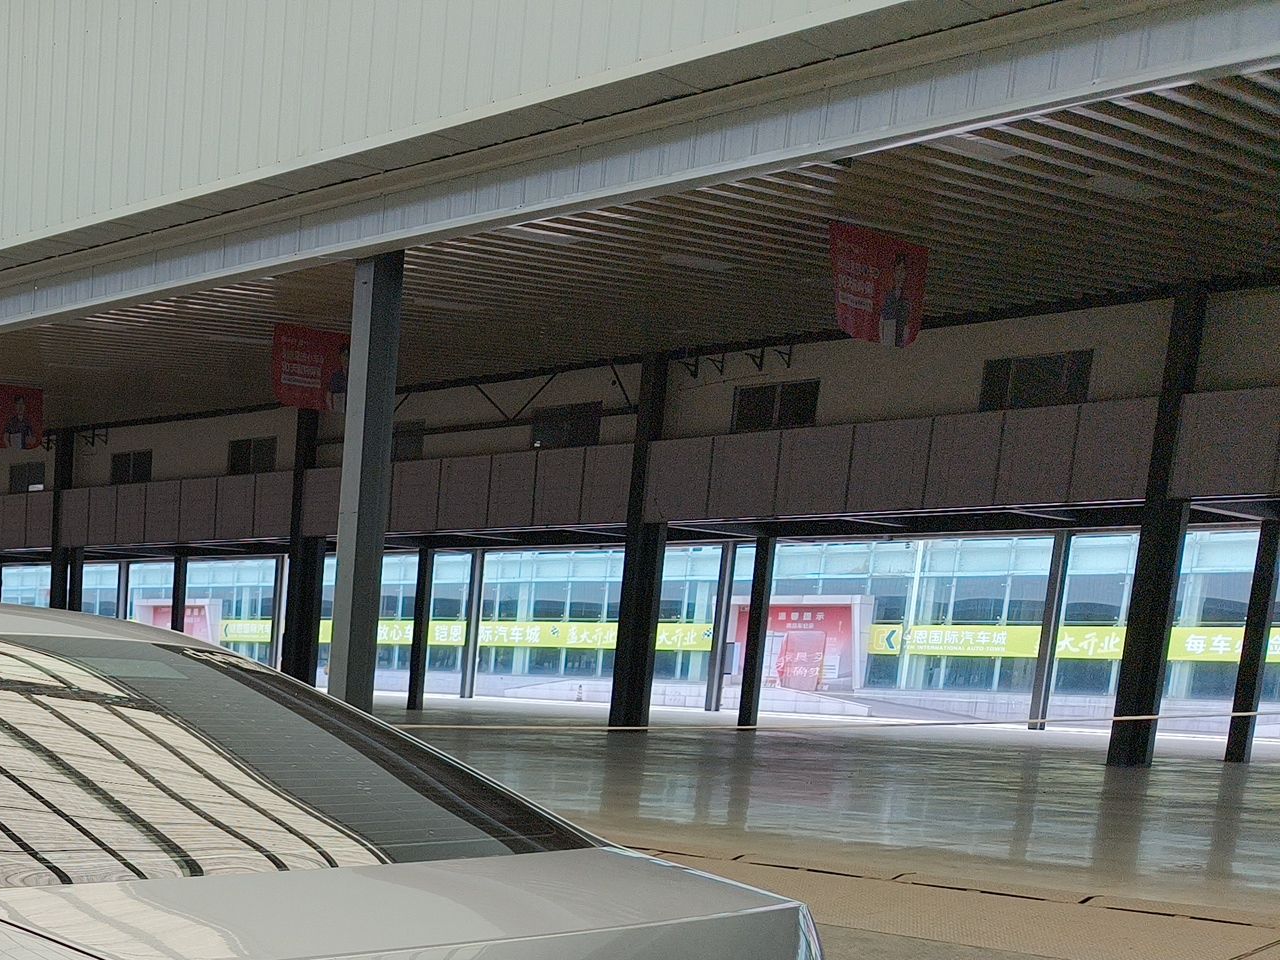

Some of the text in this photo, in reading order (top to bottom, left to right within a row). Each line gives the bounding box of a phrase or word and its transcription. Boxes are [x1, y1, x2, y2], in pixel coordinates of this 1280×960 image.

[658, 629, 697, 648] 大开业
[1033, 632, 1121, 656] 大开业
